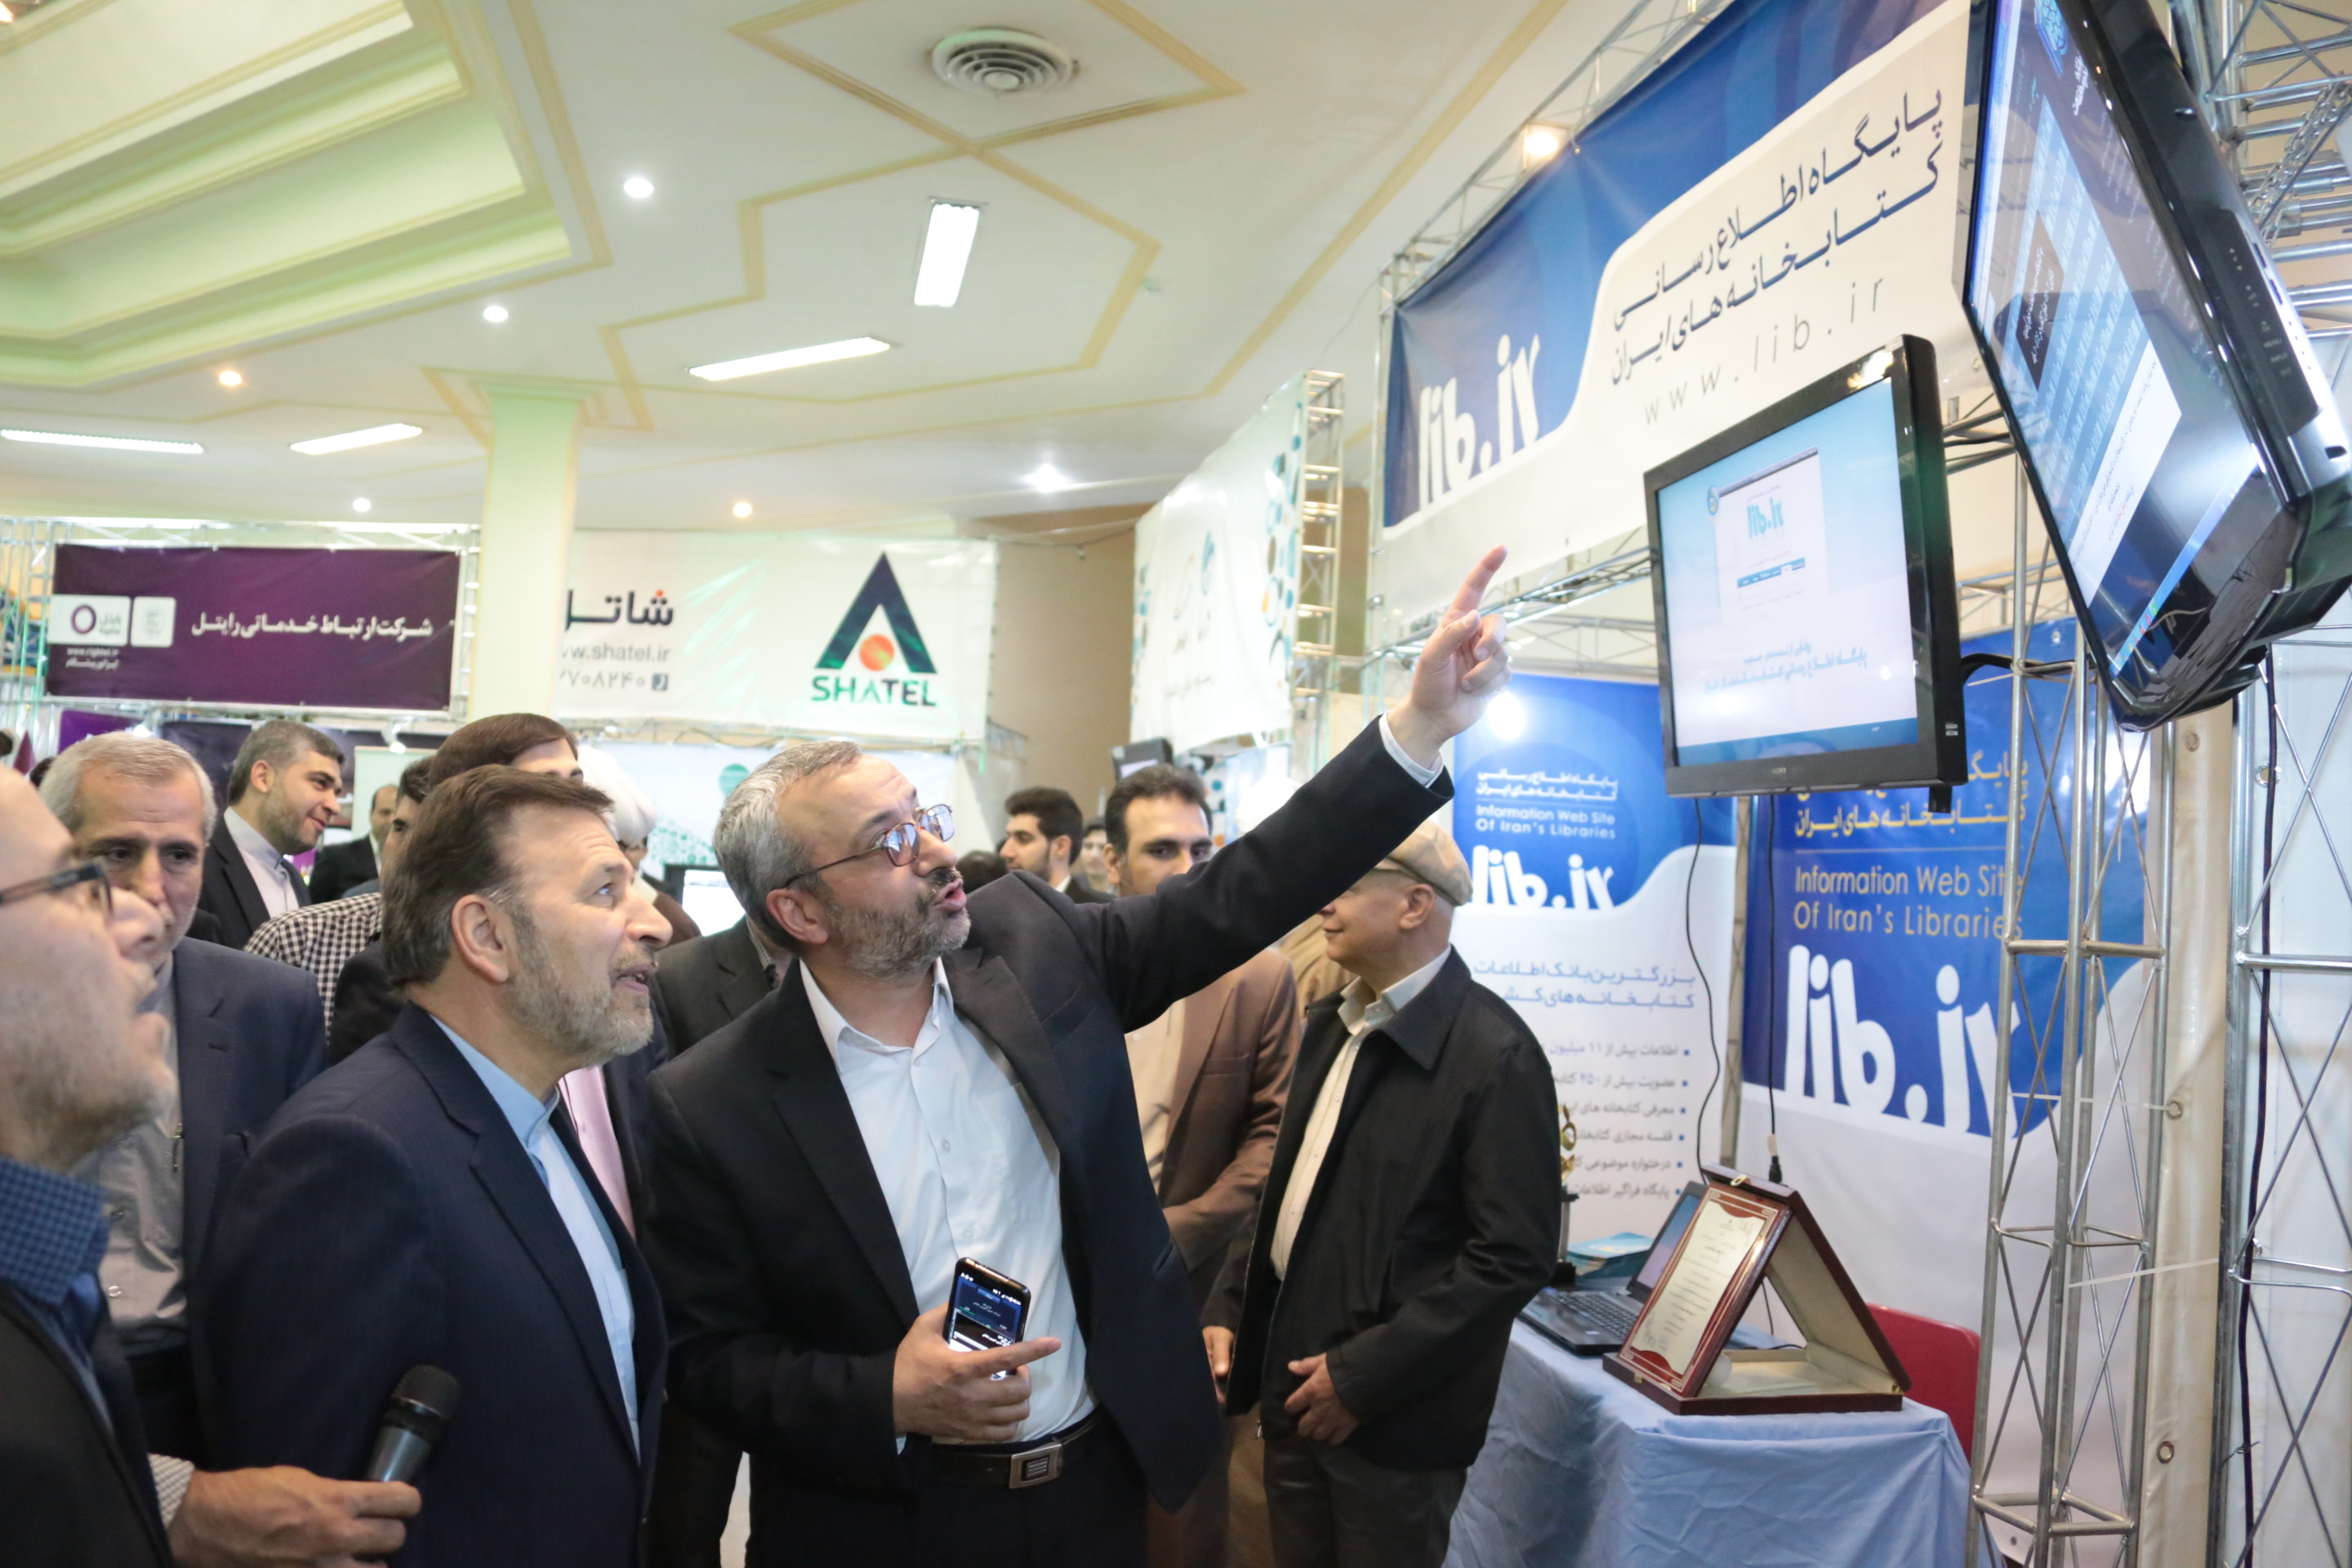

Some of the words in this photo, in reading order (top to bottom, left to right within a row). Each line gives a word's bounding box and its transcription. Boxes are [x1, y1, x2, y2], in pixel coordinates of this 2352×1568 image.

[1808, 88, 1944, 196] پایگاه
[1716, 164, 1804, 270] اطلاع
[1726, 139, 1944, 308] کتابخانه
[1614, 243, 1714, 332] رسانی
[1671, 295, 1723, 351] های
[1612, 314, 1672, 385] ایران
[1418, 332, 1541, 513] lib.ir
[191, 611, 241, 637] رایتل
[240, 612, 319, 639] خدماتی
[320, 614, 376, 640] ارتباط
[376, 616, 434, 643] شرکت
[809, 675, 937, 706] SHATEL
[1475, 804, 1555, 820] Information
[1557, 809, 1589, 823] Web
[1591, 811, 1616, 825] Site
[1475, 817, 1495, 832] Of
[1499, 820, 1545, 835] Iran's
[1550, 822, 1615, 840] Libraries
[1795, 806, 1843, 839] ایران
[1472, 844, 1615, 911] lib.ir
[1795, 864, 1909, 895] Information
[1916, 865, 1971, 897] Web
[1793, 901, 1820, 930] Of
[1828, 902, 1894, 934] Iran's
[1784, 945, 2021, 1140] lib.ir
